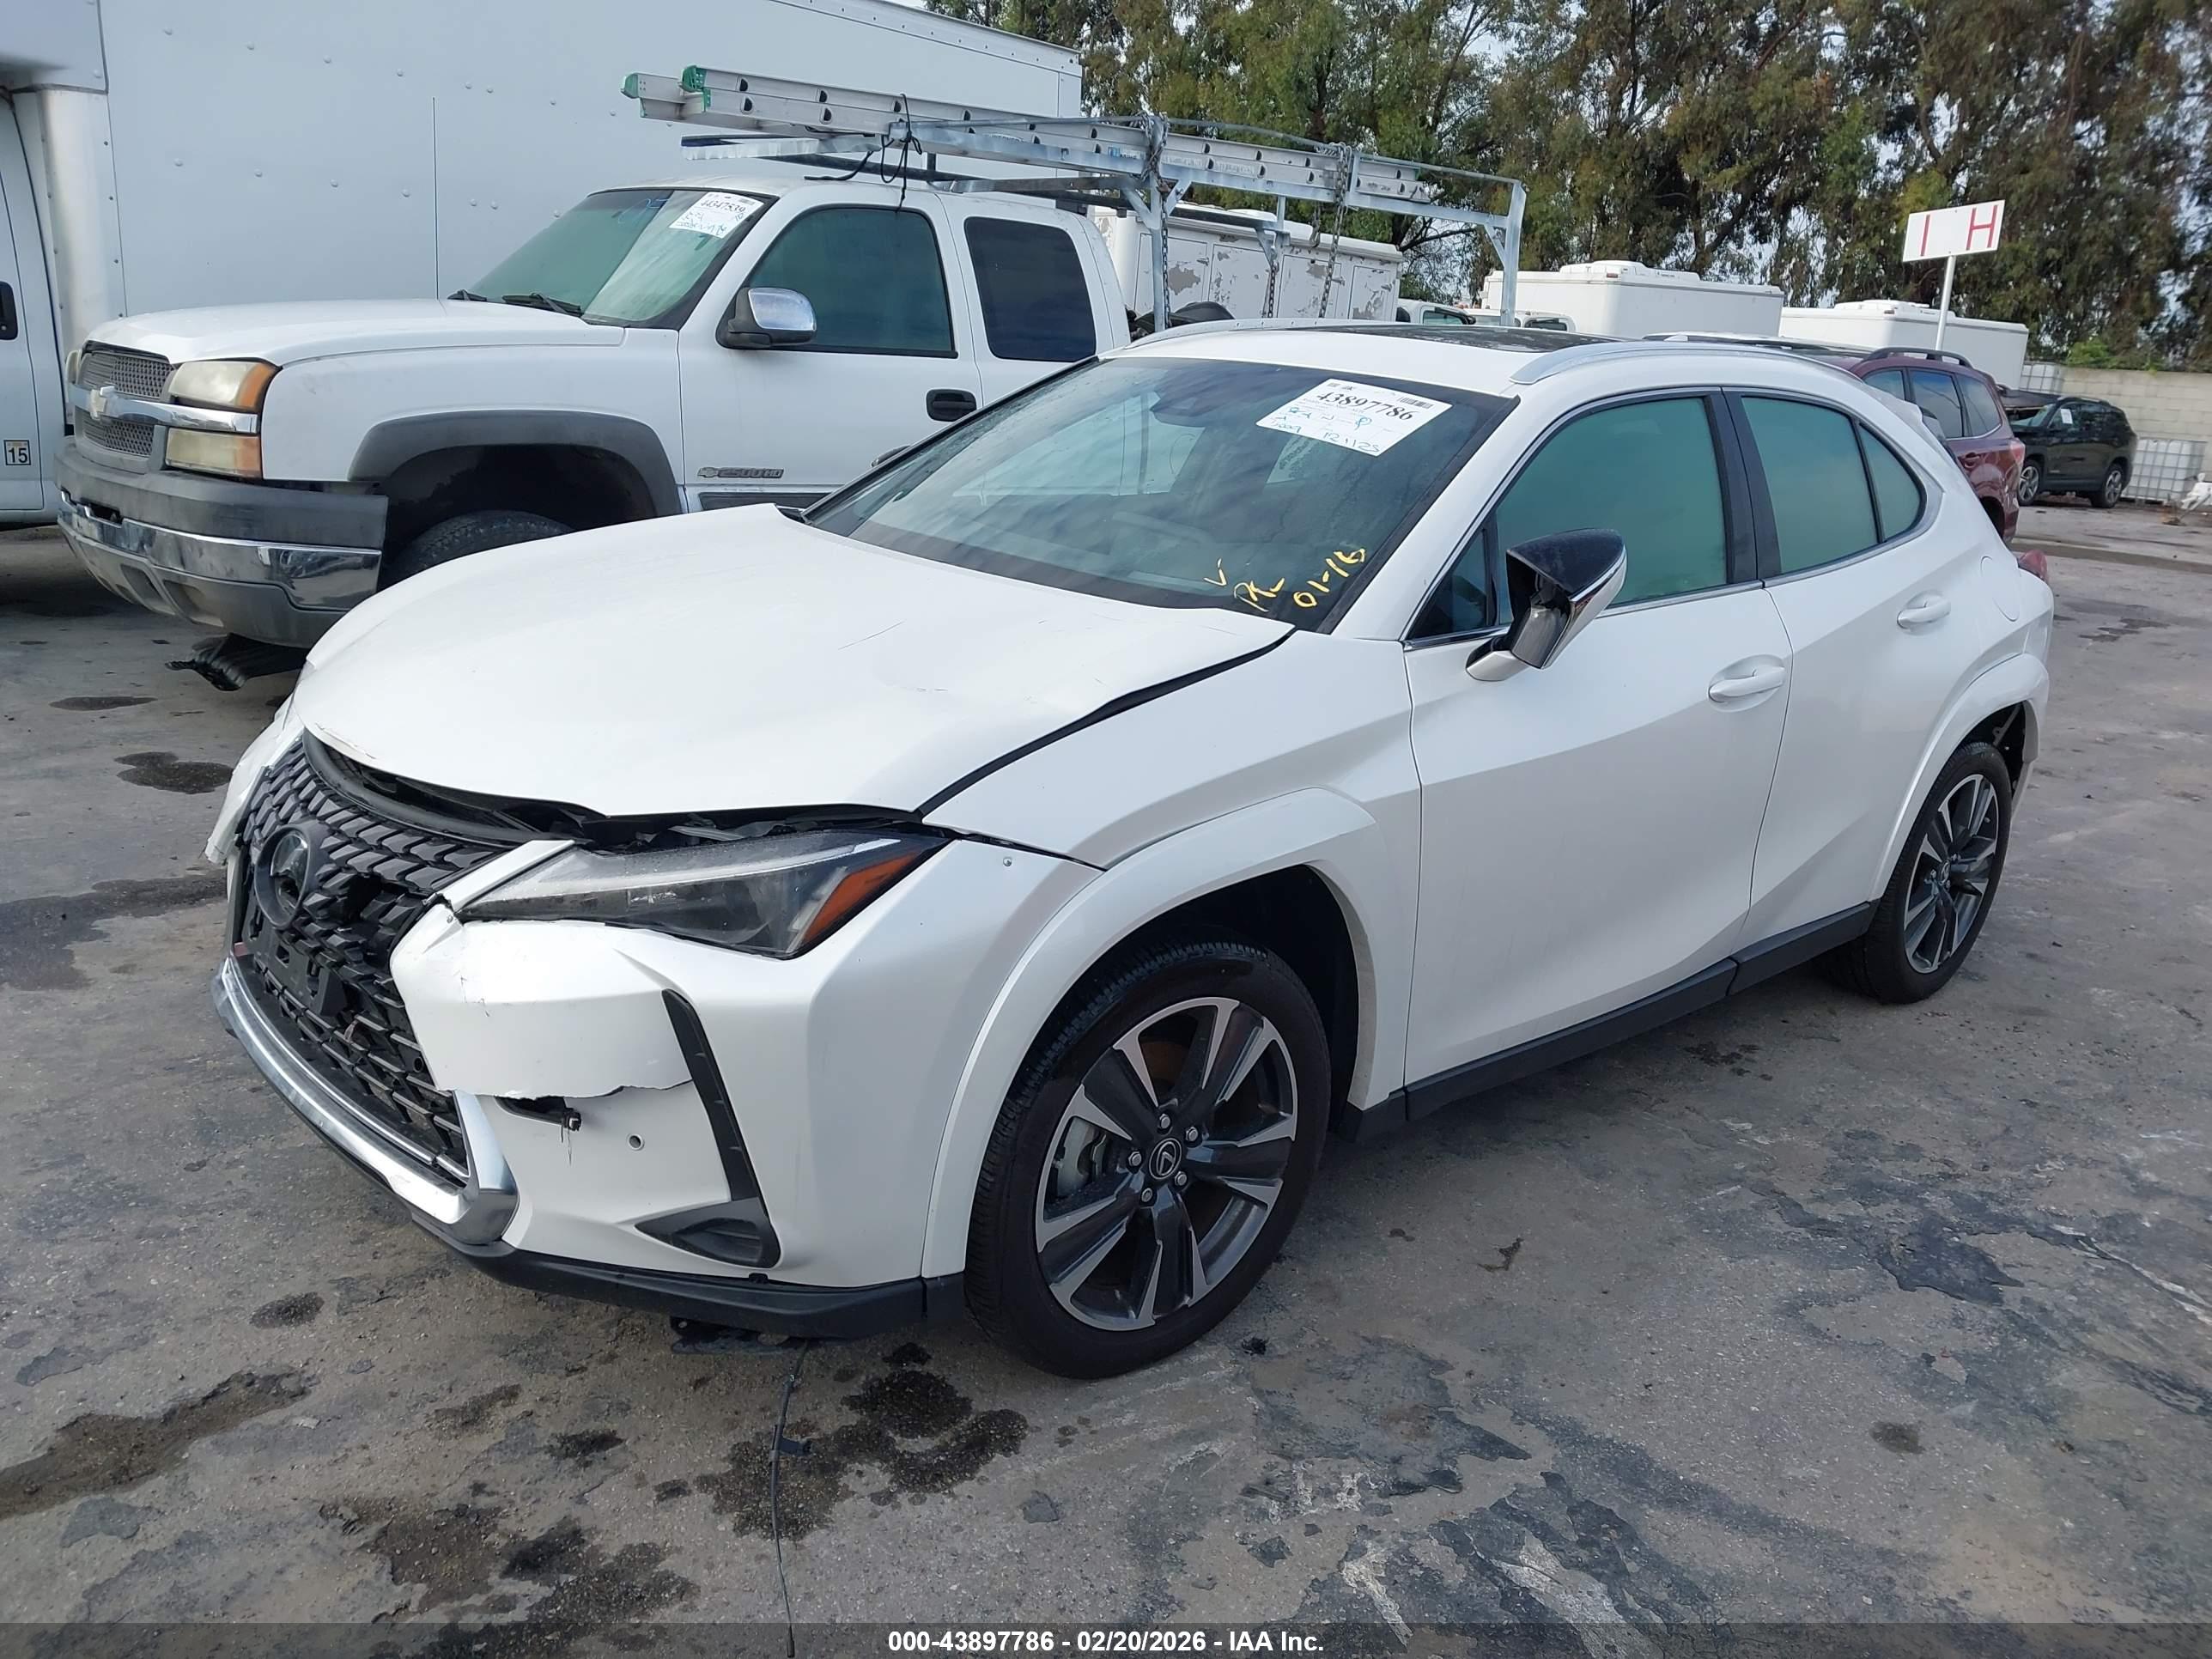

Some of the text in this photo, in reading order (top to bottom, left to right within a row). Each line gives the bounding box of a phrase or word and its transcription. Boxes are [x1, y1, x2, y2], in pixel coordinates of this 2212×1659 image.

[1965, 204, 1999, 251] H
[1316, 392, 1418, 421] 43897786
[8, 447, 28, 464] 15
